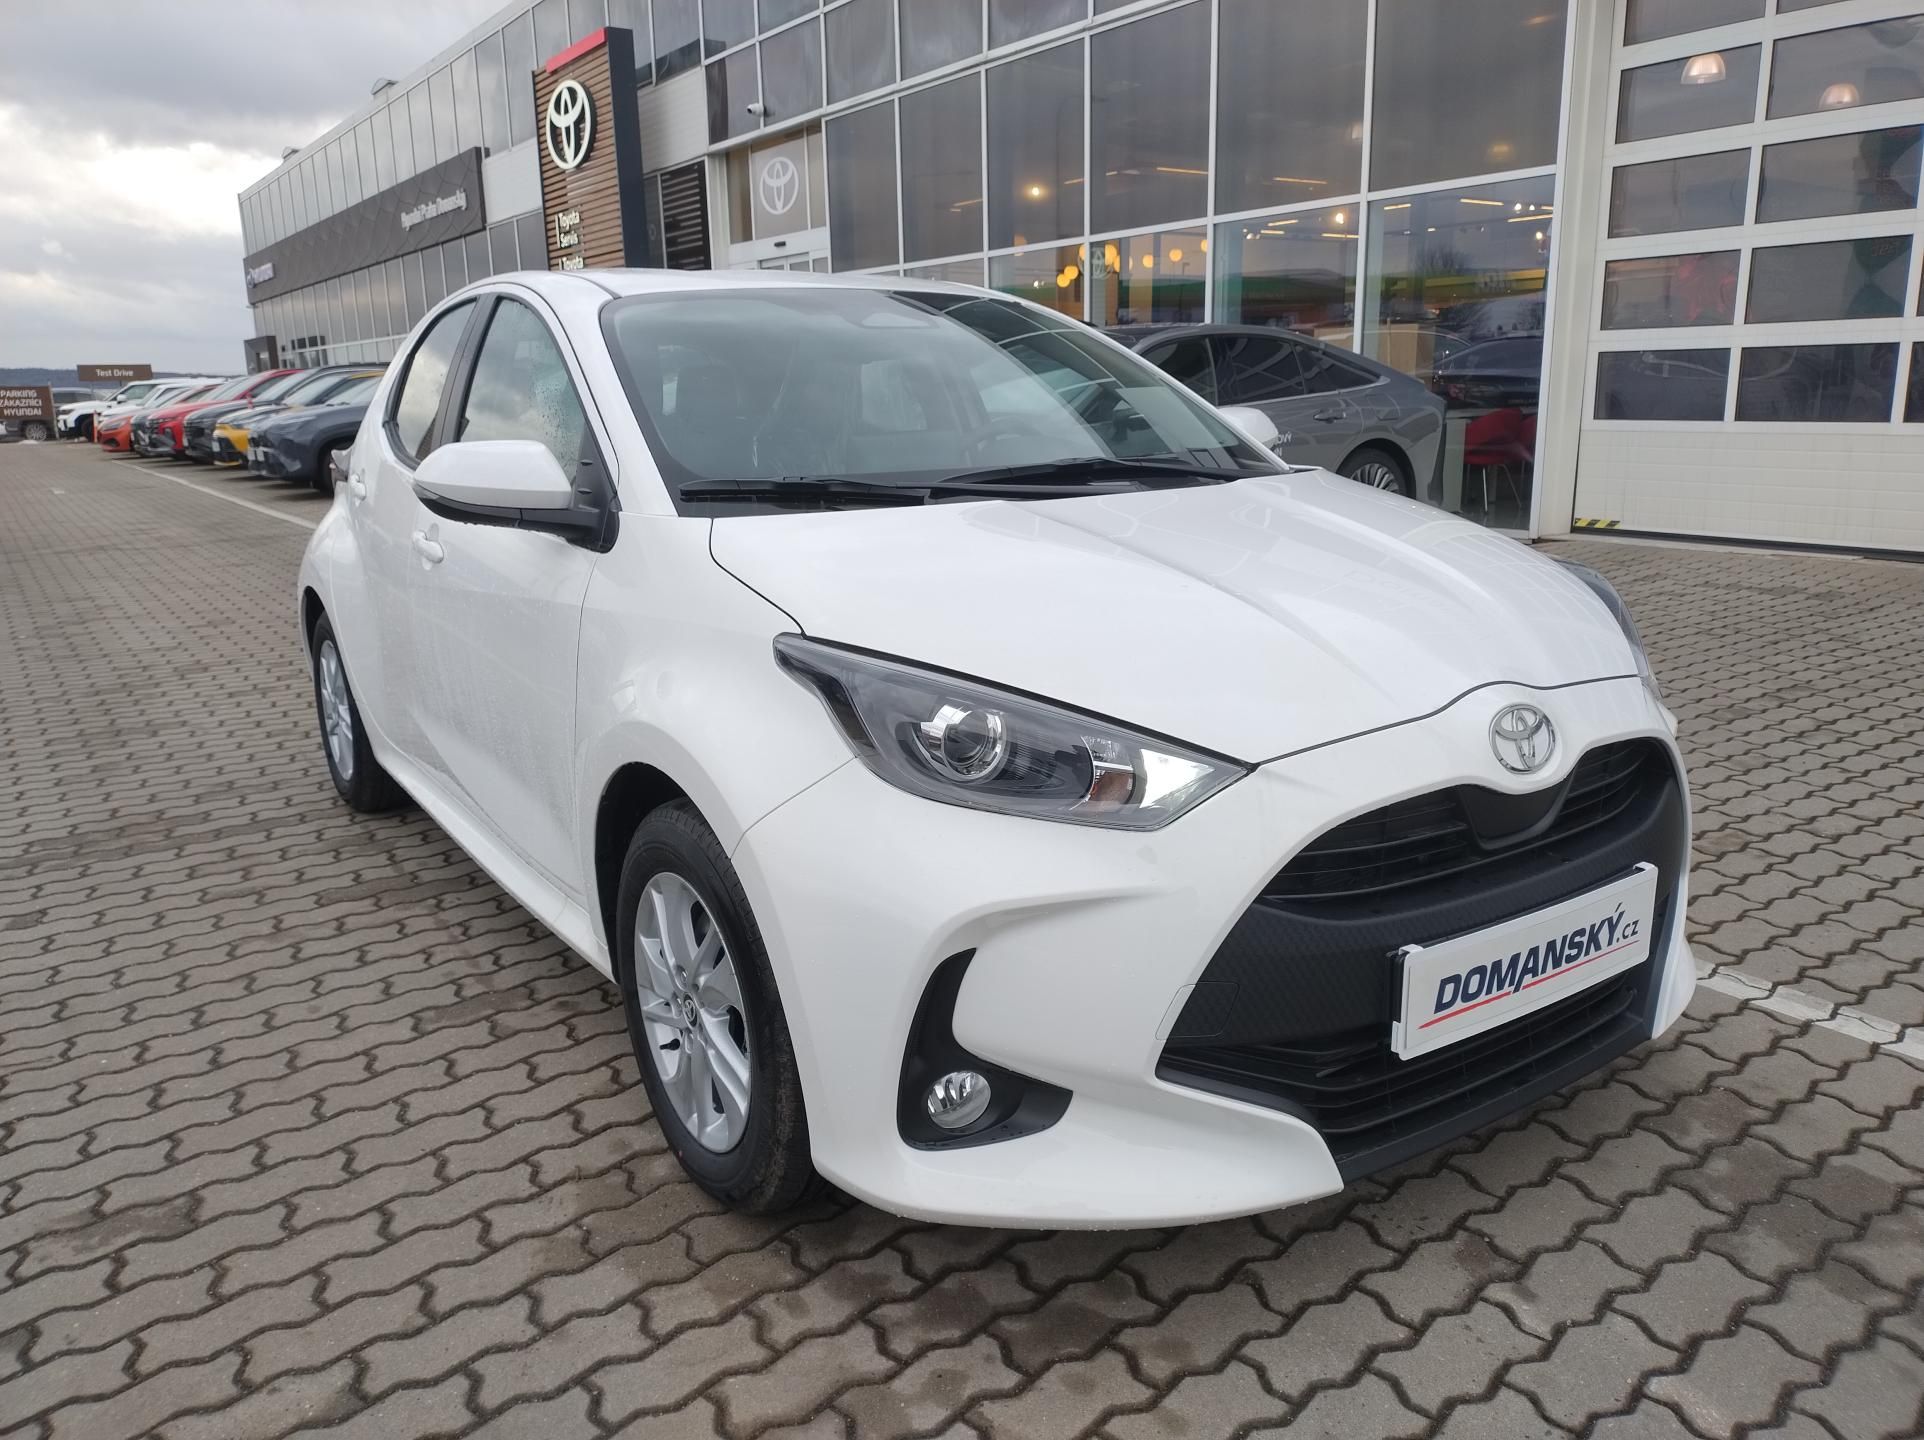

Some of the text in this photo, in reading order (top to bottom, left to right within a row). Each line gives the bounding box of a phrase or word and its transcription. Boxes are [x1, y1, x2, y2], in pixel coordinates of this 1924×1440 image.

[558, 210, 580, 230] Toyota
[560, 230, 578, 248] Servis
[113, 369, 134, 377] Drive
[0, 389, 37, 398] PARKING
[3, 408, 42, 416] HYUNDAI
